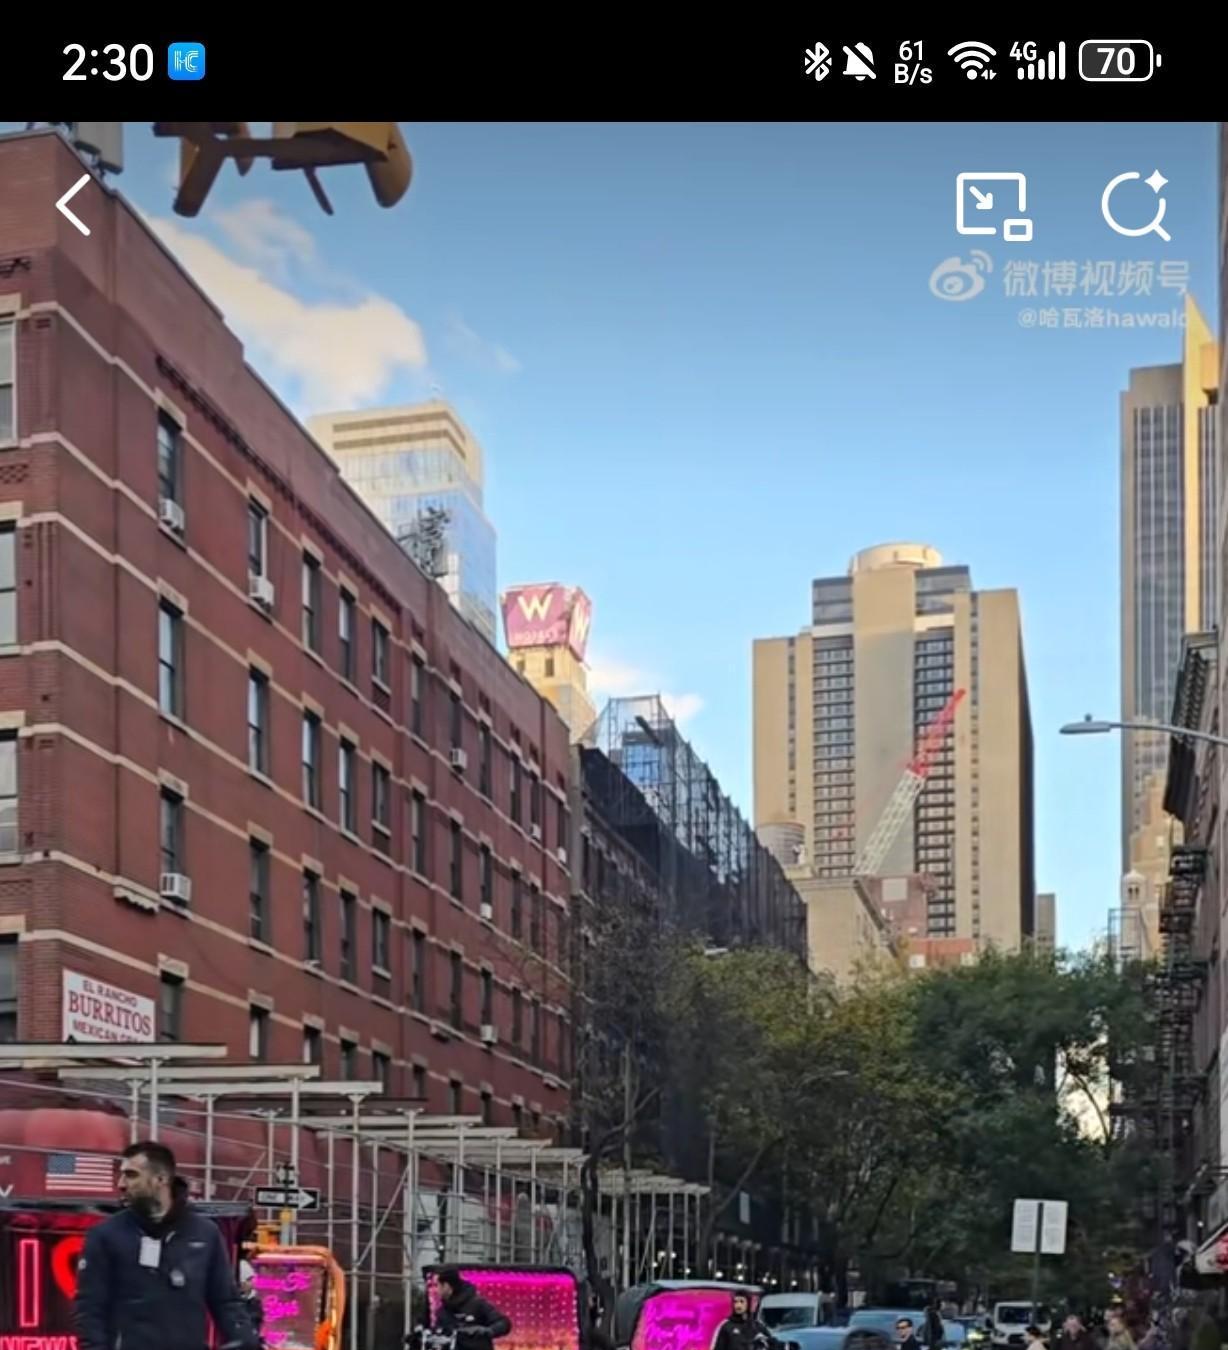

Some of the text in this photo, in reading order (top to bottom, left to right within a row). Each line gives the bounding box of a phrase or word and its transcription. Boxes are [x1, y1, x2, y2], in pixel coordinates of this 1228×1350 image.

[517, 592, 554, 622] W
[82, 980, 138, 1008] EL RANCHO
[69, 990, 152, 1036] BURRITOS
[73, 1018, 119, 1042] MEXICAN
[20, 1238, 40, 1328] I
